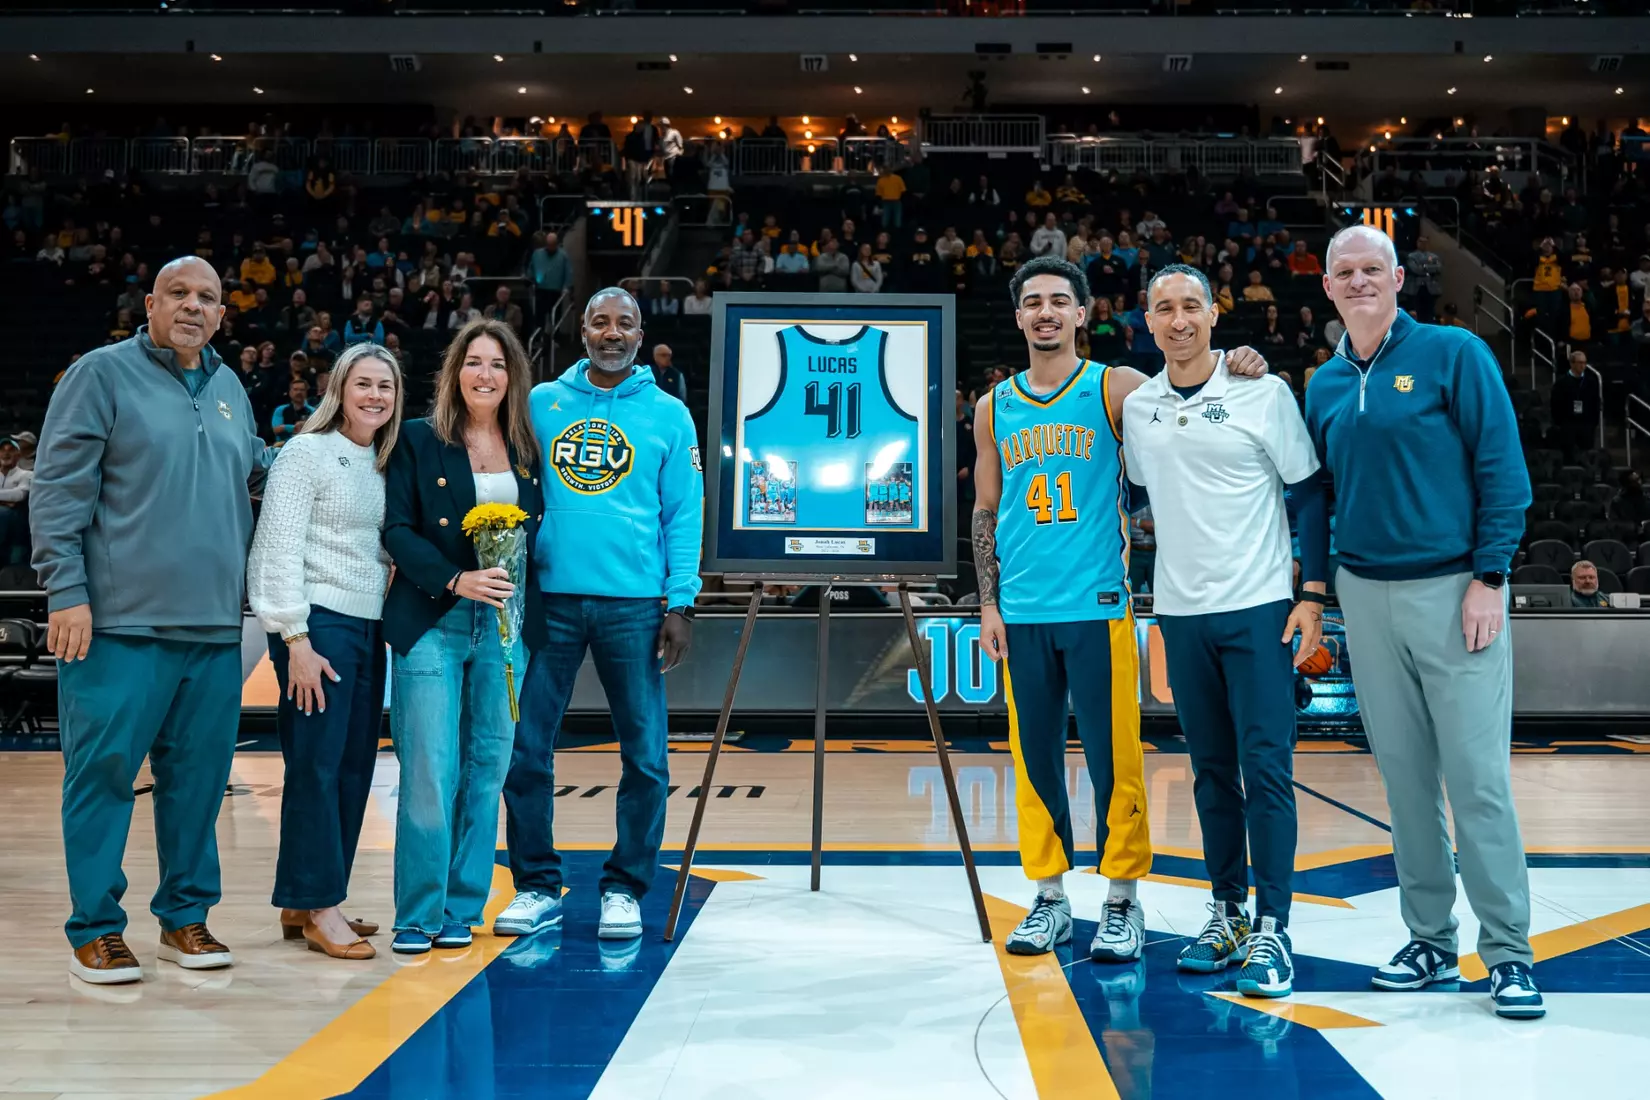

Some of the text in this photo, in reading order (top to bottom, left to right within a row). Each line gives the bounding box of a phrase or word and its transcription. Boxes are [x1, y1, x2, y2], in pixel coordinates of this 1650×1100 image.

[804, 57, 823, 71] 117
[1170, 57, 1188, 71] 117
[612, 207, 643, 246] 41
[808, 355, 857, 374] LUCAS
[803, 380, 861, 439] 41
[554, 442, 630, 470] RGV
[1000, 422, 1096, 473] MARQUETTE
[1025, 471, 1079, 525] 41
[830, 591, 849, 600] POSS
